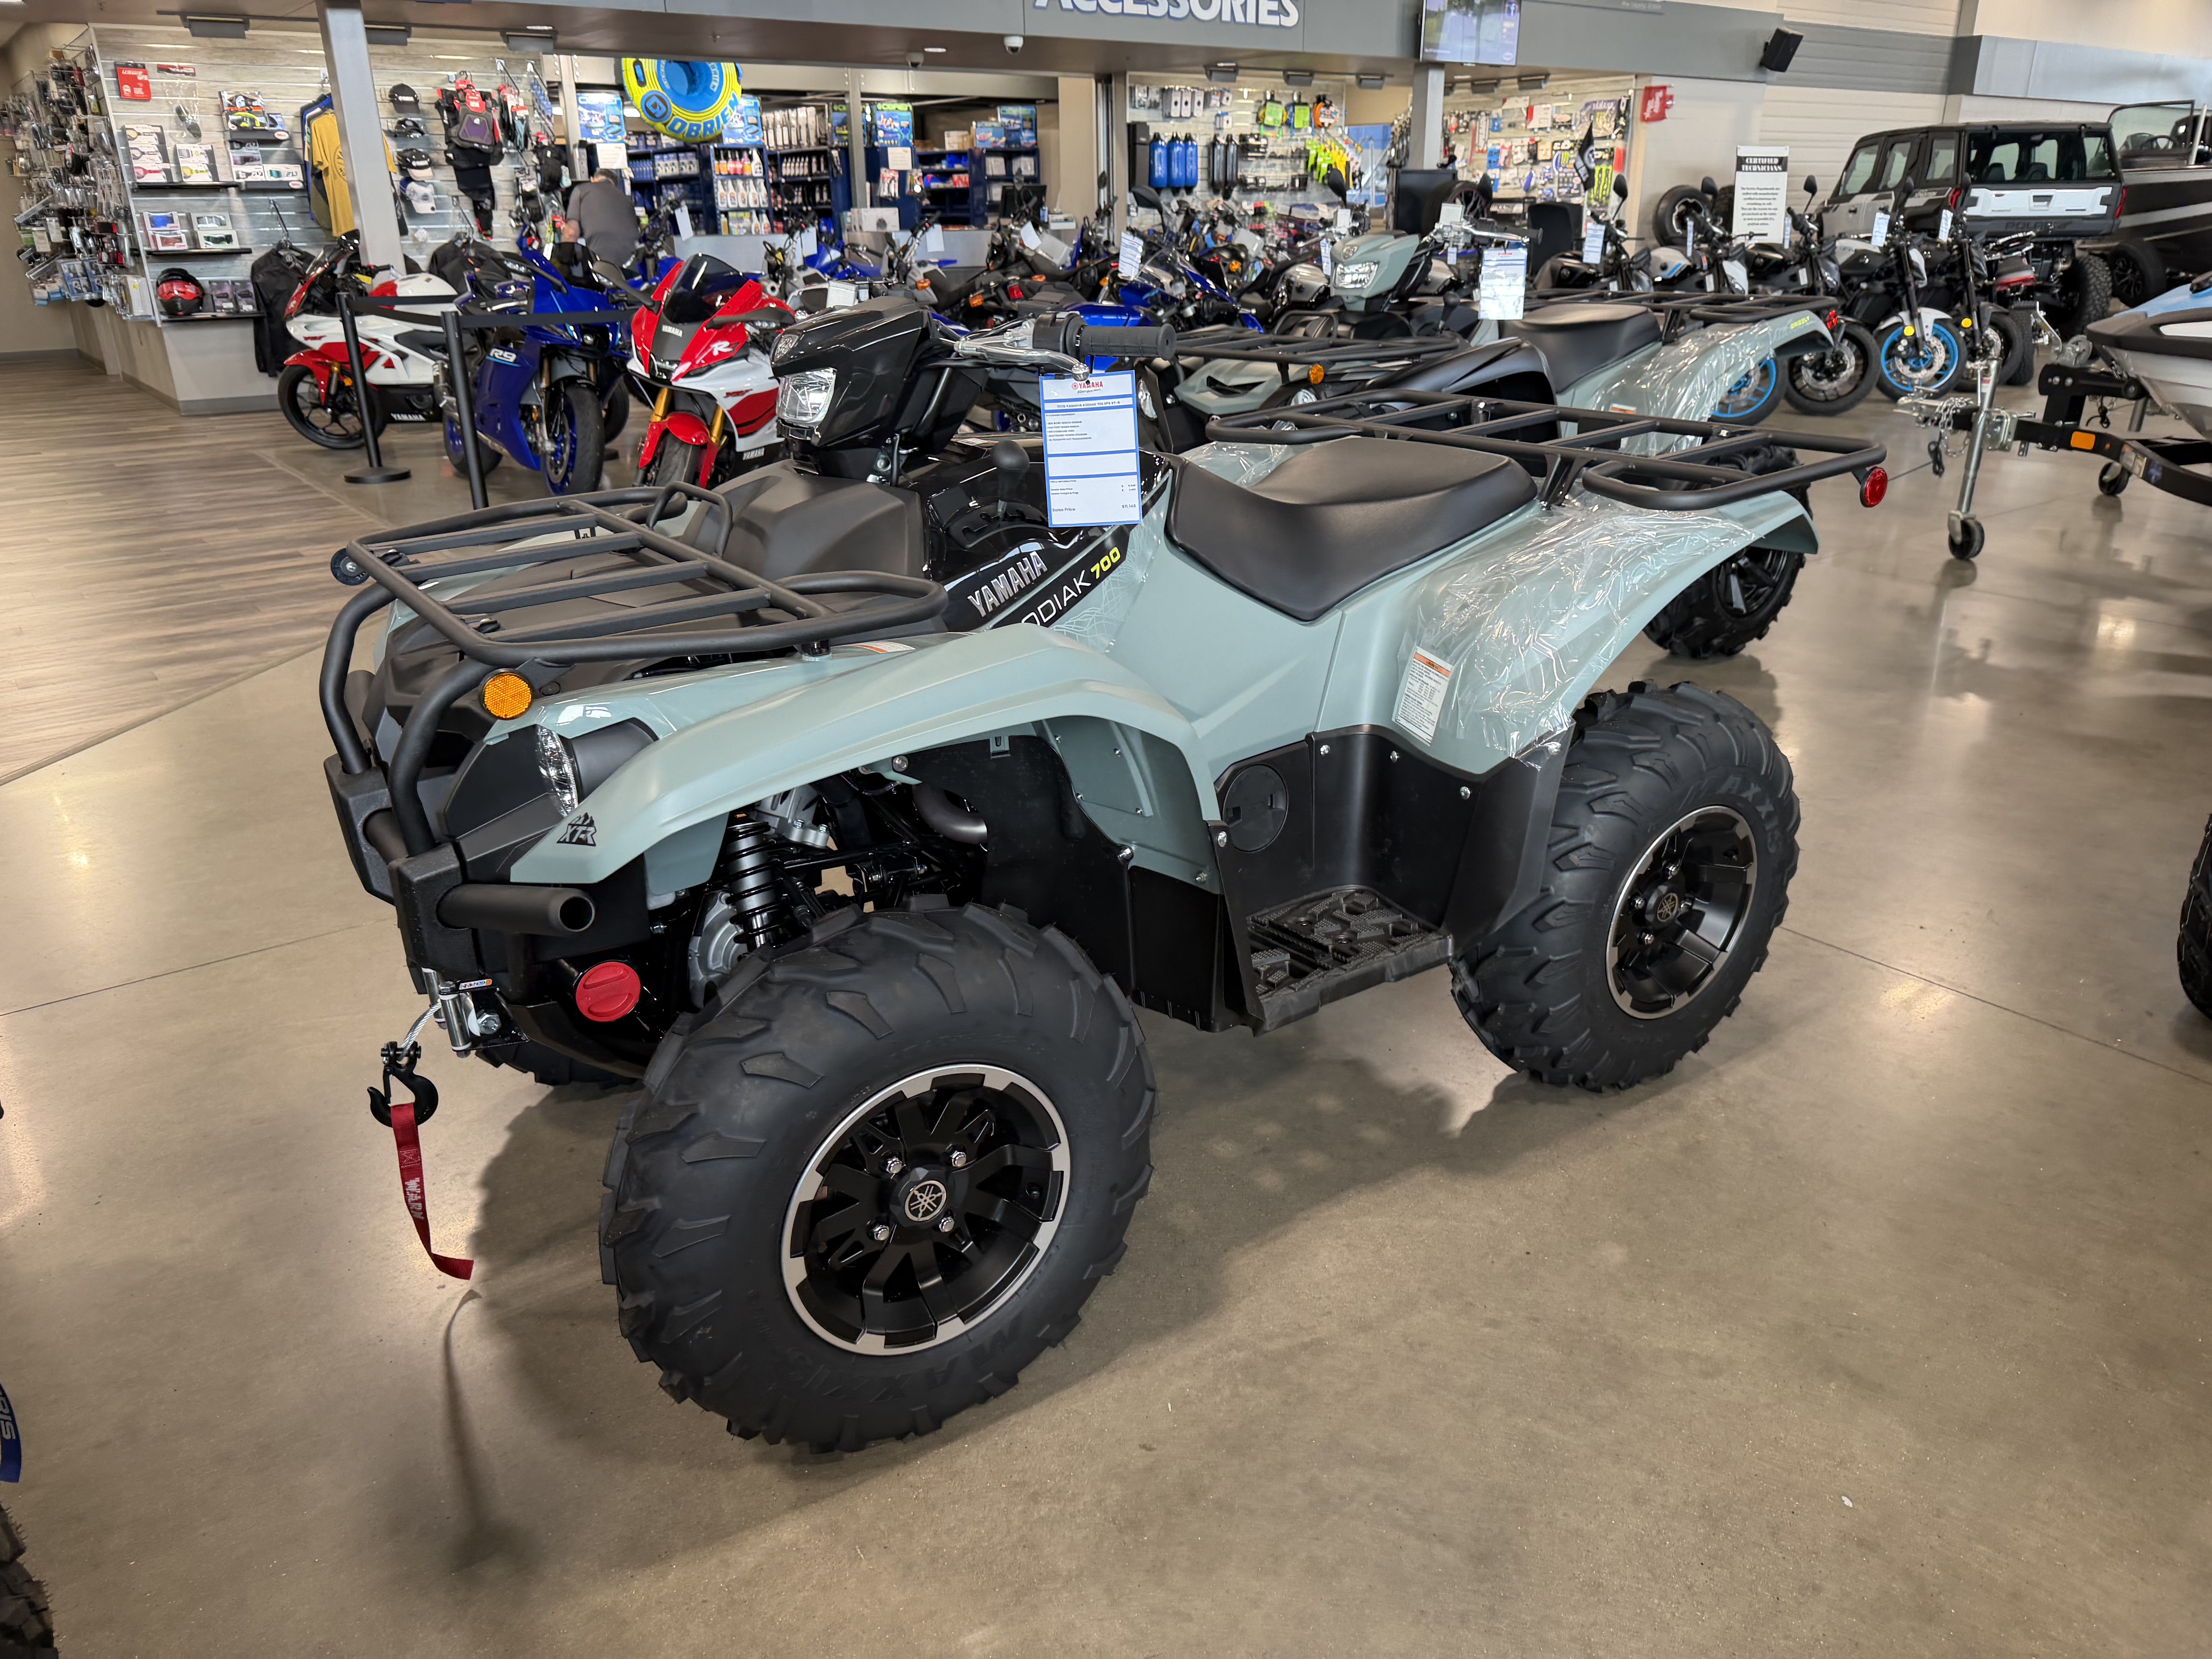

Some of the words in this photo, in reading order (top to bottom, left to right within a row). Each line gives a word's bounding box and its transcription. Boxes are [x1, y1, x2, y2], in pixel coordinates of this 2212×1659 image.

[662, 325, 683, 337] YAMAHA
[489, 348, 517, 362] R9
[391, 412, 426, 421] YAMAHA
[967, 551, 1048, 617] YAMAHA
[1021, 569, 1091, 626] ODIAK
[1090, 546, 1121, 580] 700
